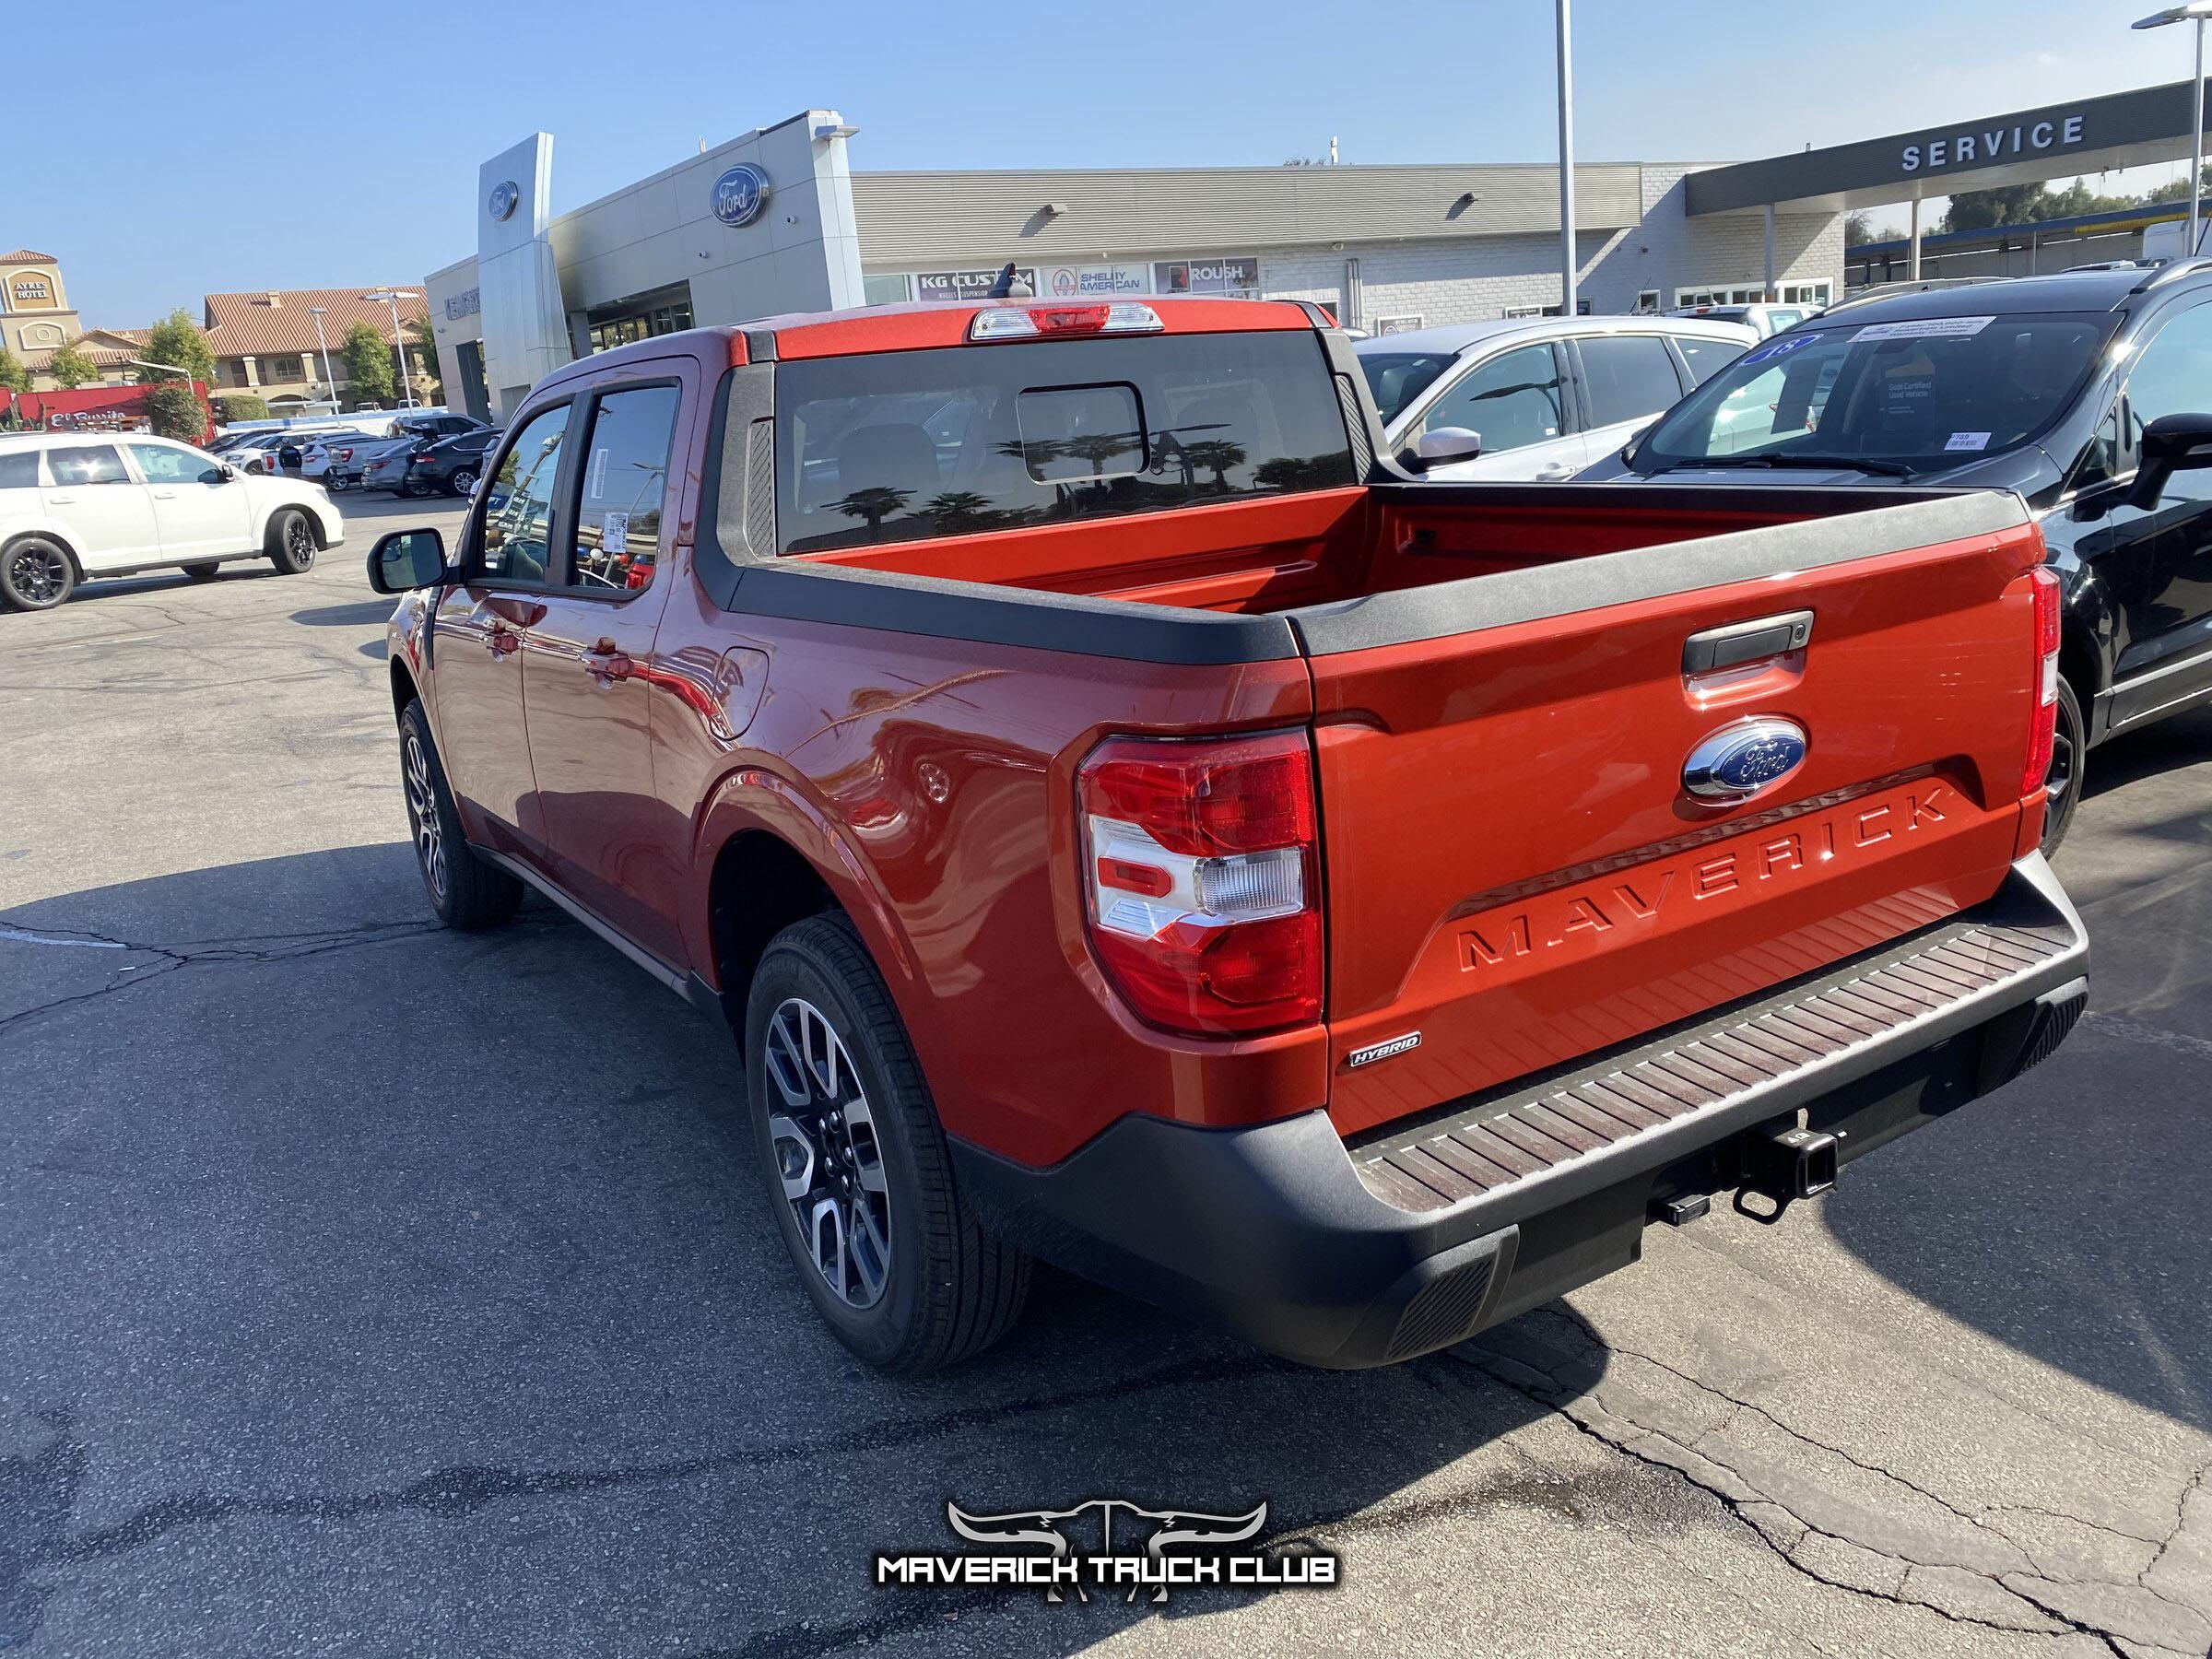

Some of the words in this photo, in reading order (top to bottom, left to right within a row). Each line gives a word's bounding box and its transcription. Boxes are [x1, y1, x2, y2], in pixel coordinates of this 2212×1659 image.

[1902, 116, 2083, 171] SERVICE
[719, 179, 748, 217] Ford
[922, 276, 947, 288] KG
[951, 272, 1033, 288] CUSTM
[1190, 265, 1242, 281] ROUSH
[16, 281, 47, 290] AYRES
[18, 290, 48, 299] HOTEL
[51, 412, 71, 427] El
[1740, 739, 1791, 782] Ford
[1458, 788, 1946, 972] MAVERICK
[1354, 1036, 1418, 1064] HYBRID
